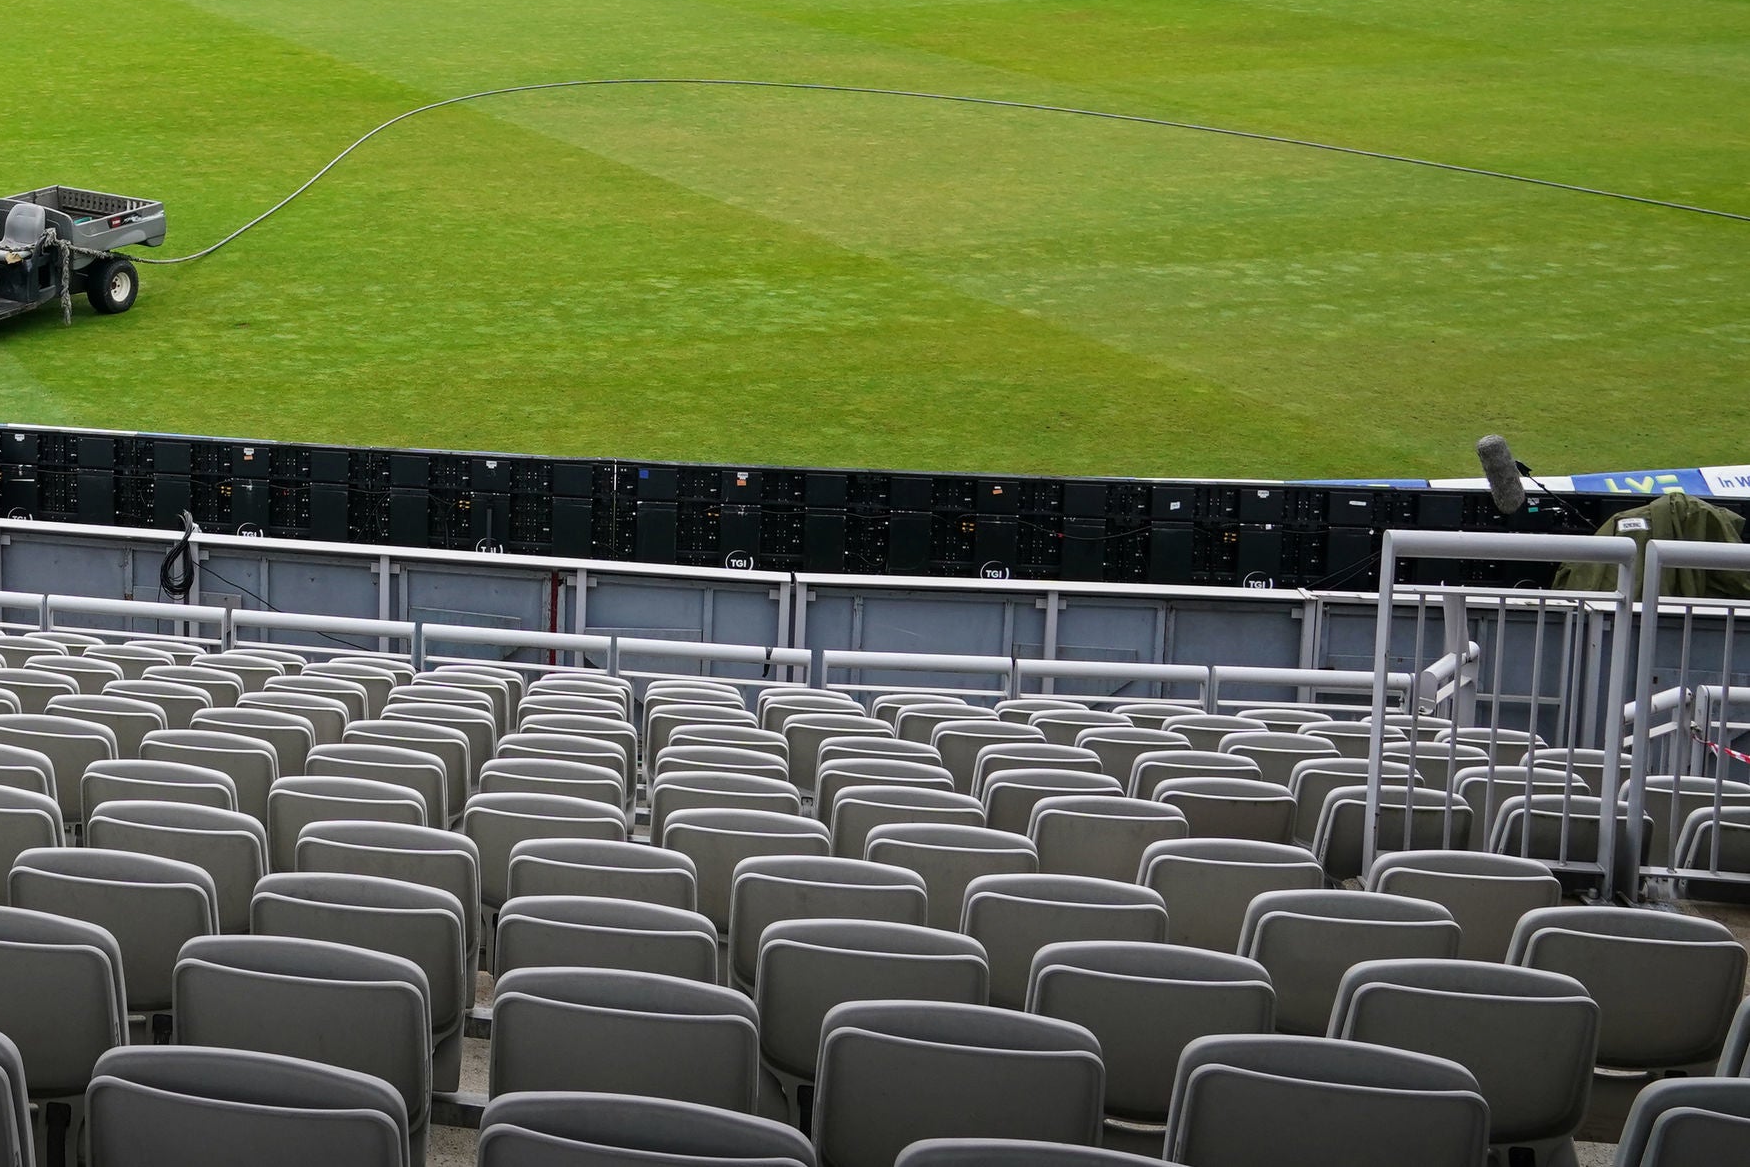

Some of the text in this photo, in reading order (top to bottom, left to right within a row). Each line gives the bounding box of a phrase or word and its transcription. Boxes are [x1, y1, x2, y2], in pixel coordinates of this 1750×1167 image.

[1718, 477, 1735, 488] In
[730, 559, 747, 567] TGI
[985, 570, 1002, 578] TGI
